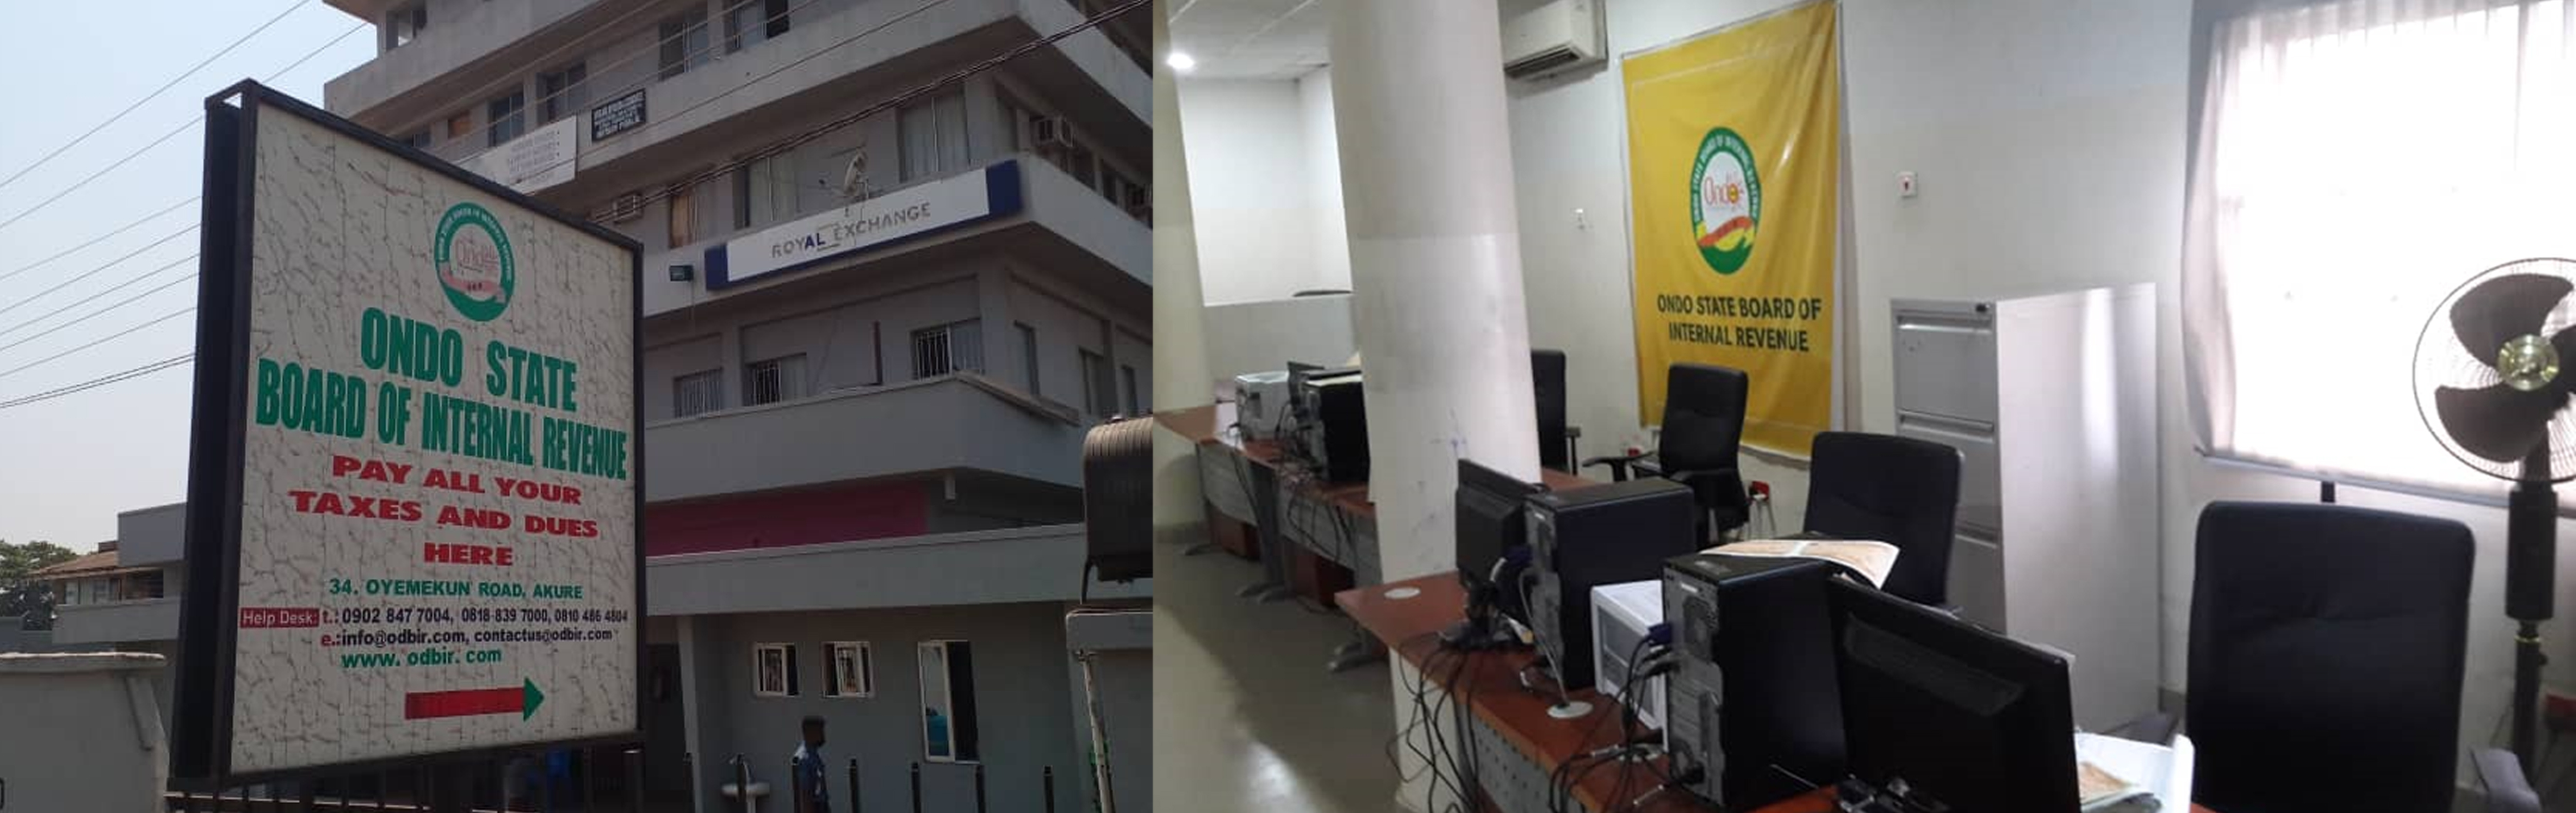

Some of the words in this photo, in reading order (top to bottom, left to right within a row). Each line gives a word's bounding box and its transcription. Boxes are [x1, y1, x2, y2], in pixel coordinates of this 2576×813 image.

[772, 233, 826, 259] ROYAL
[834, 203, 931, 240] EXCHANGE
[1657, 295, 1693, 314] ONDO
[1696, 296, 1735, 316] STATE
[1739, 297, 1795, 319] BOARD
[1799, 298, 1822, 320] OF
[1669, 322, 1732, 345] INTERNAL
[1736, 327, 1809, 352] REVENUE
[361, 307, 462, 387] ONDO
[487, 340, 577, 412] STATE
[256, 358, 366, 439] BOARD
[378, 382, 411, 445] OF
[422, 392, 534, 466] INTERNAL
[543, 416, 626, 480] REVENUE
[333, 455, 412, 484] PAY
[423, 468, 485, 494] ALL
[495, 477, 581, 505] YOUR
[288, 490, 422, 521] TAXES
[437, 505, 512, 529] AND
[525, 515, 598, 537] DUES
[424, 542, 513, 566] HERE
[367, 579, 470, 596] OYEMEKUN
[533, 585, 584, 599] AKURE
[243, 610, 276, 625] Help
[386, 608, 413, 623] 847
[466, 648, 502, 663] com
